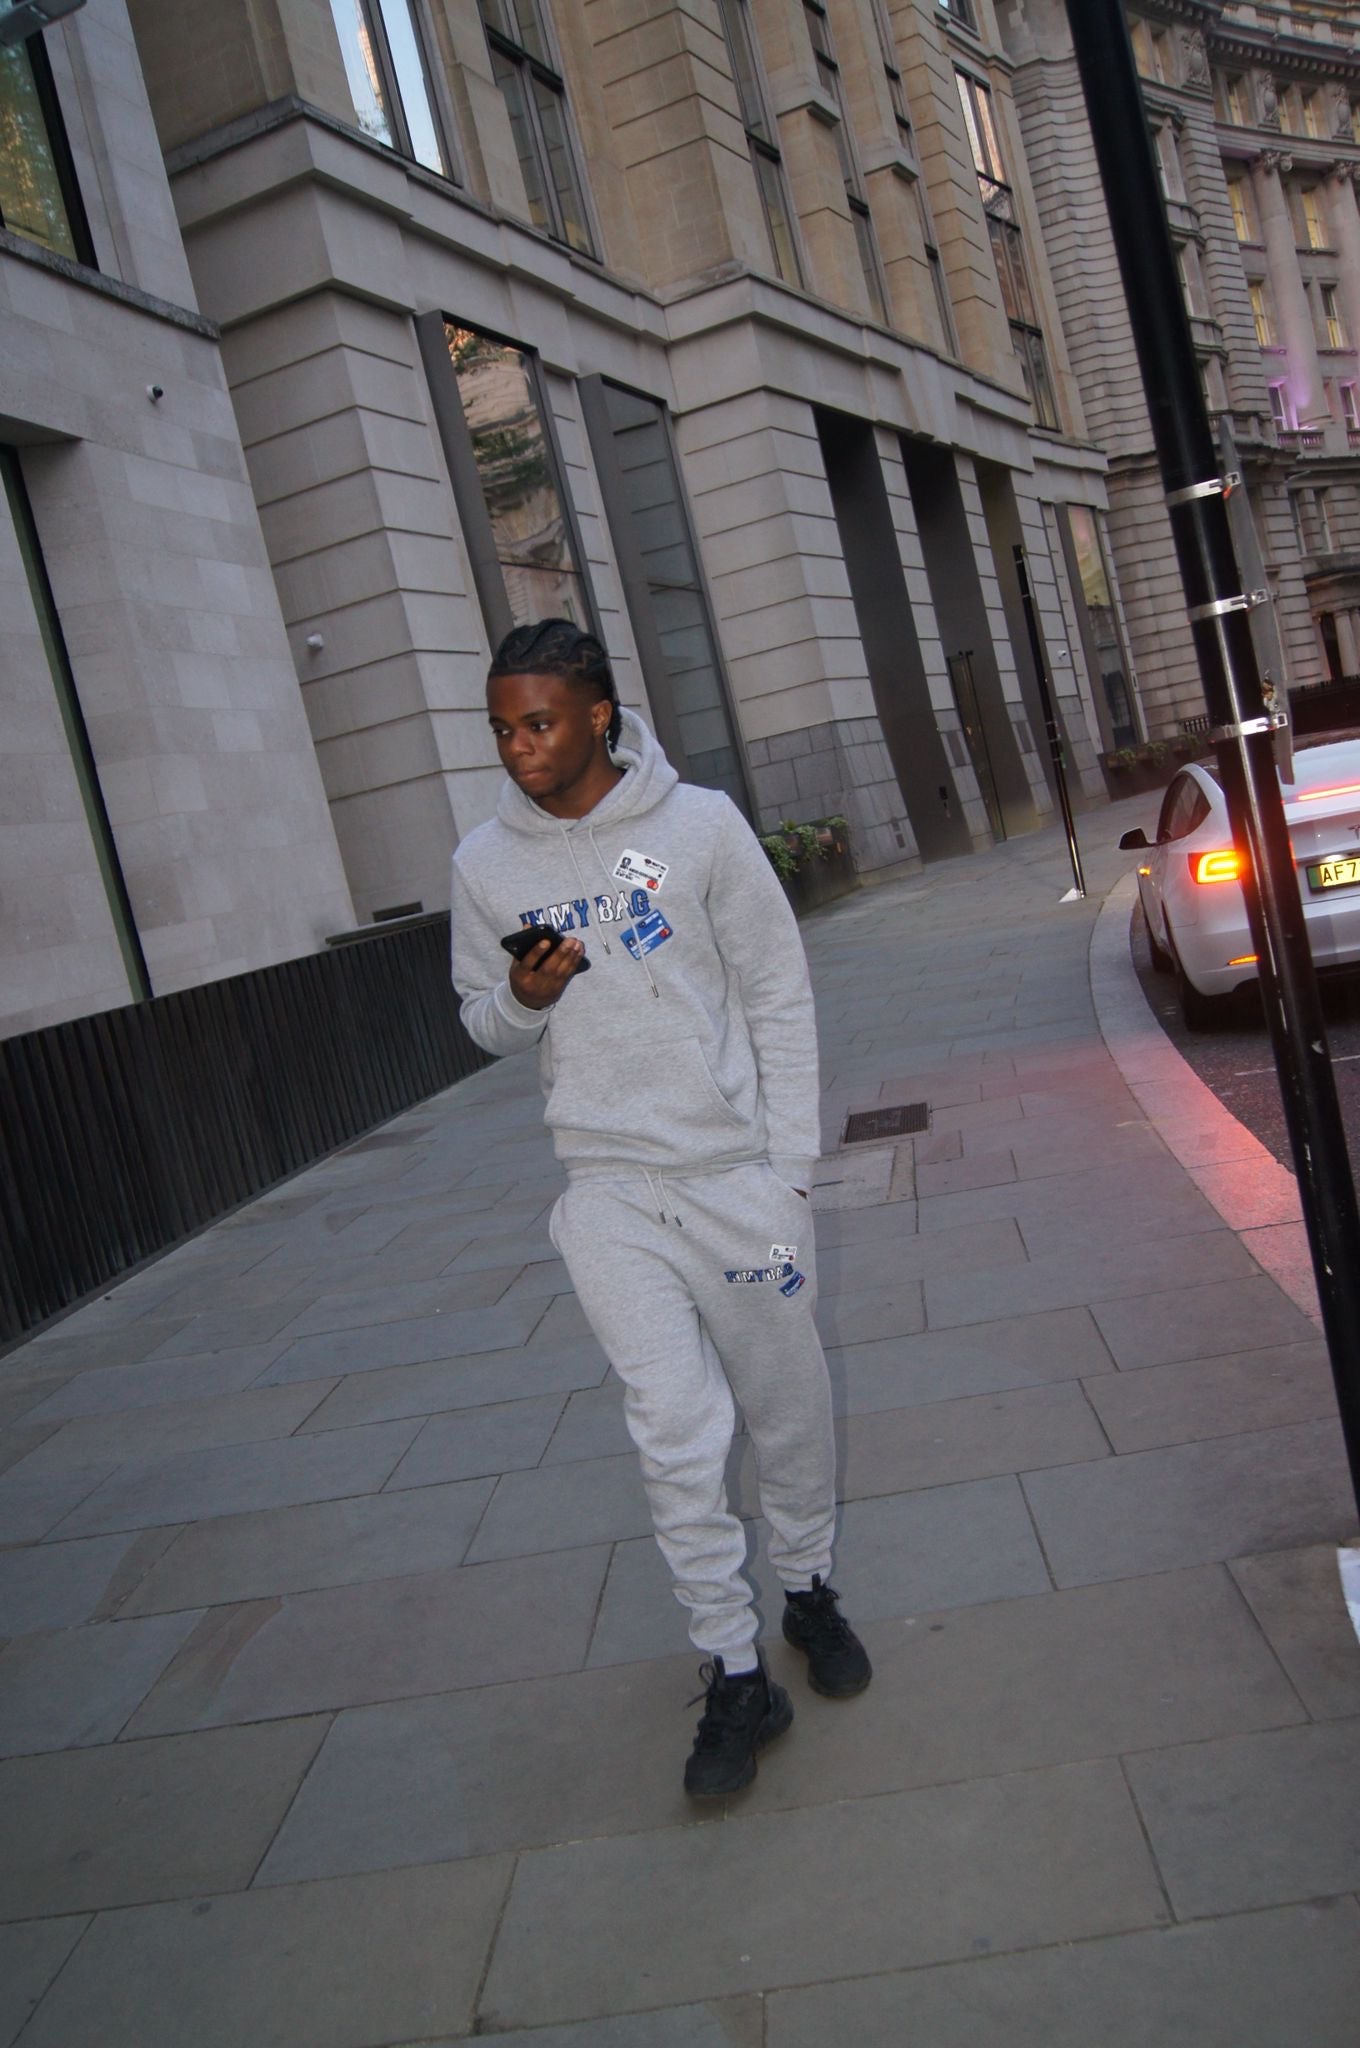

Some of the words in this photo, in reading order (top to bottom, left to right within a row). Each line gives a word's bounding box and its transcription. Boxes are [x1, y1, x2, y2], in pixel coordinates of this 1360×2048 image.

[1323, 862, 1360, 883] AF7
[547, 898, 589, 932] MY
[594, 889, 650, 923] BAG
[741, 1269, 763, 1283] MY
